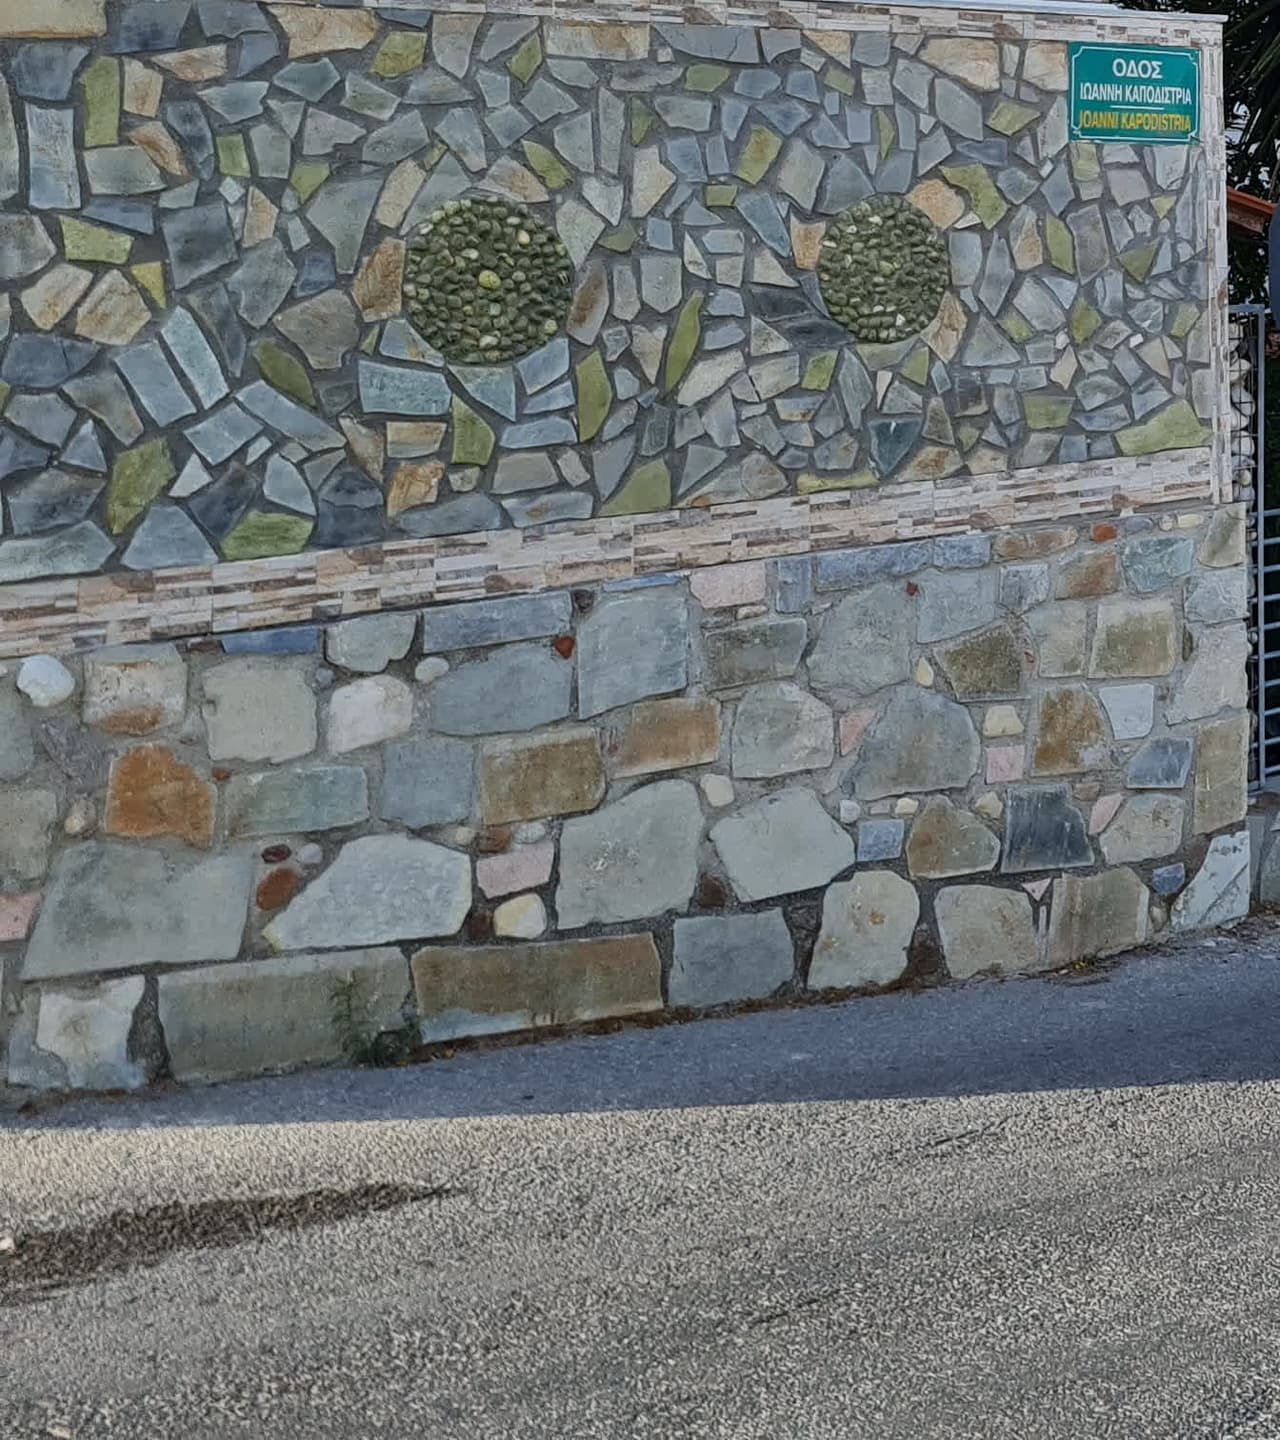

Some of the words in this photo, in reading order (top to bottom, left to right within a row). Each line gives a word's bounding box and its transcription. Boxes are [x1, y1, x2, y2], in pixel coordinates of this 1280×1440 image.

[1112, 58, 1163, 79] ΟΔΟΣ
[1080, 82, 1122, 102] ΙΩΑΝΝΗ
[1125, 84, 1192, 105] ΚΑΠΟΔΙΣΤΡΙΑ
[1079, 110, 1119, 129] IOANNI
[1121, 112, 1191, 131] KAPODISTRIA
